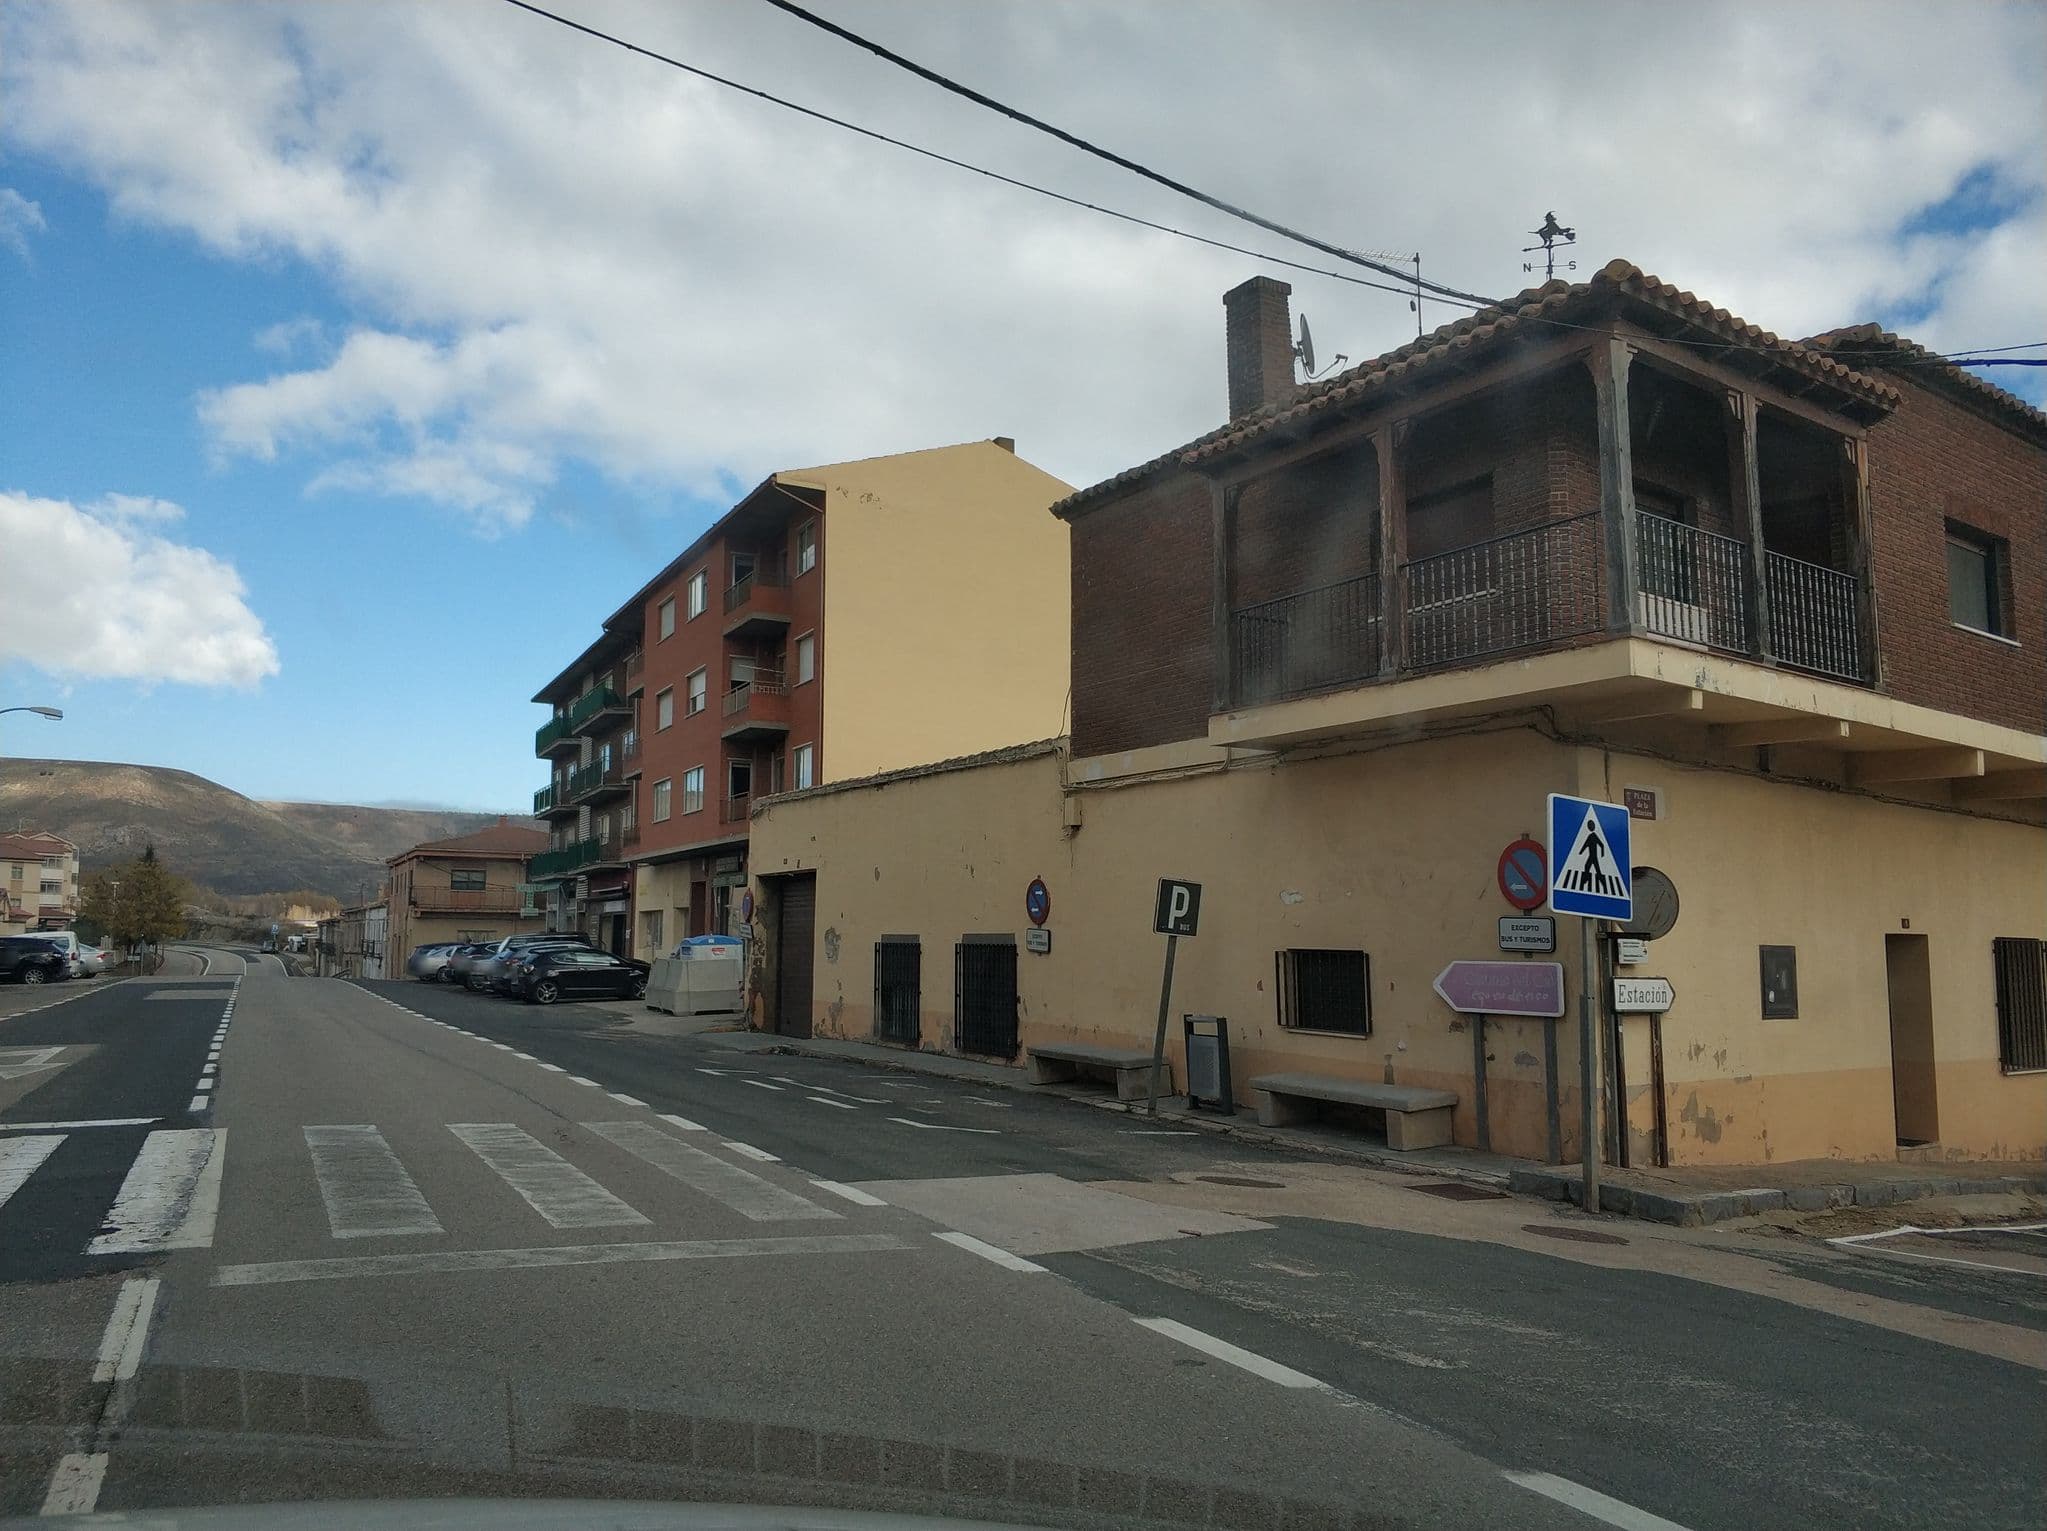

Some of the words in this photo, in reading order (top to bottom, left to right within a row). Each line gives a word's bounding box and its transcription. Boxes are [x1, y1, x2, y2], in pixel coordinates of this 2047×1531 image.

[1523, 263, 1532, 272] N
[1568, 260, 1577, 270] S
[1168, 885, 1190, 929] P
[1179, 923, 1190, 931] BUS
[1618, 984, 1667, 1004] Estación
